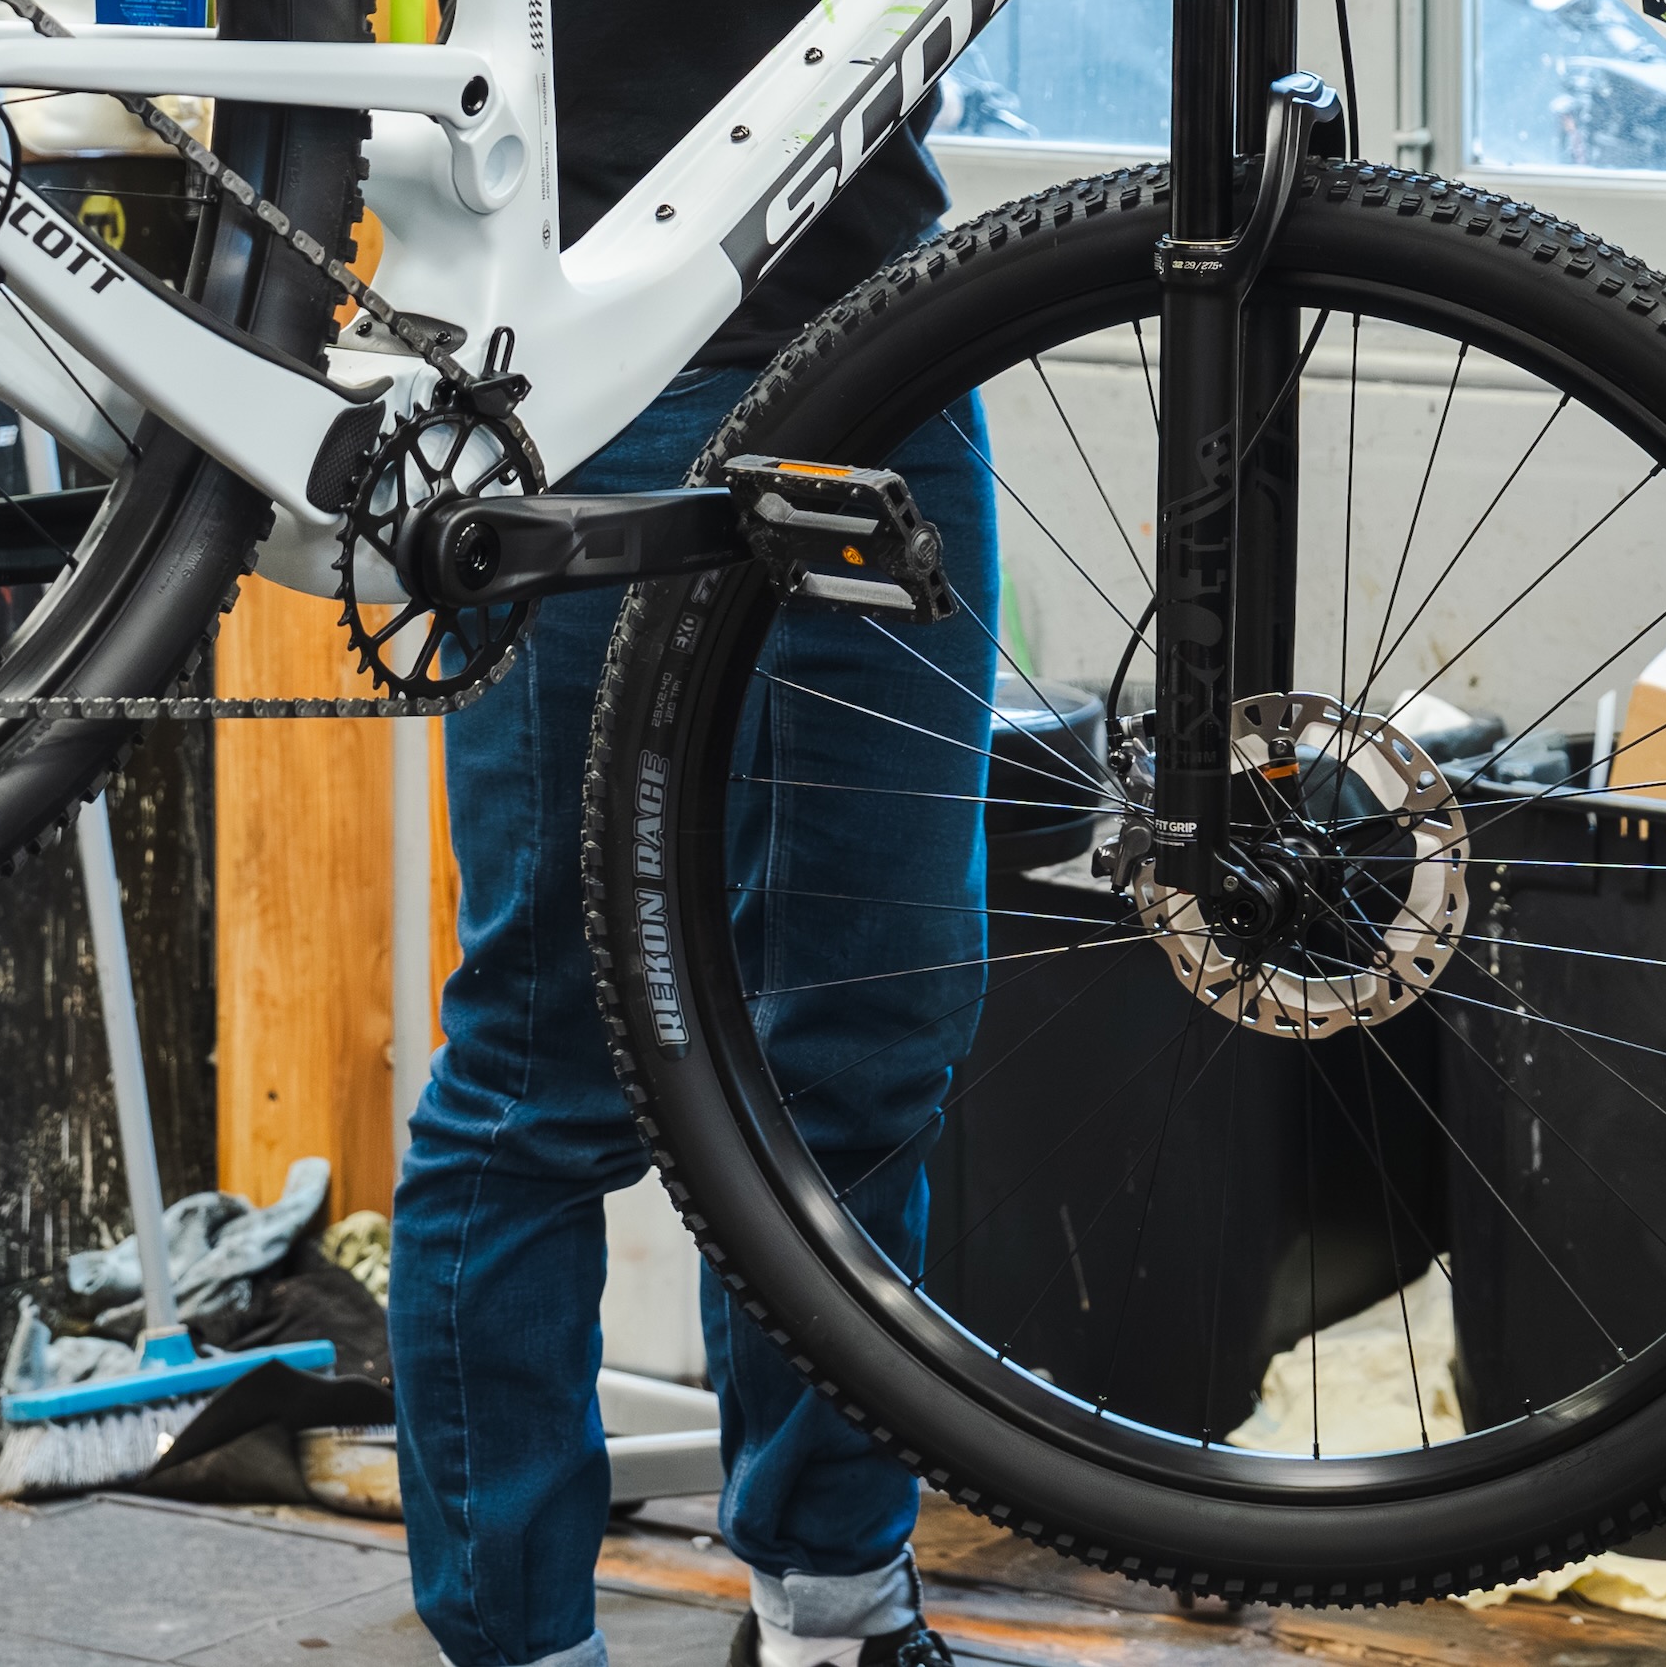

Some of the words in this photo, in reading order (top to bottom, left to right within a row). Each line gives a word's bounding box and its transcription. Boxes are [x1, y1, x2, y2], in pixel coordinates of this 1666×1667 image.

[633, 748, 671, 881] RACE
[1169, 821, 1197, 833] GRIP
[635, 888, 690, 1046] REKON
